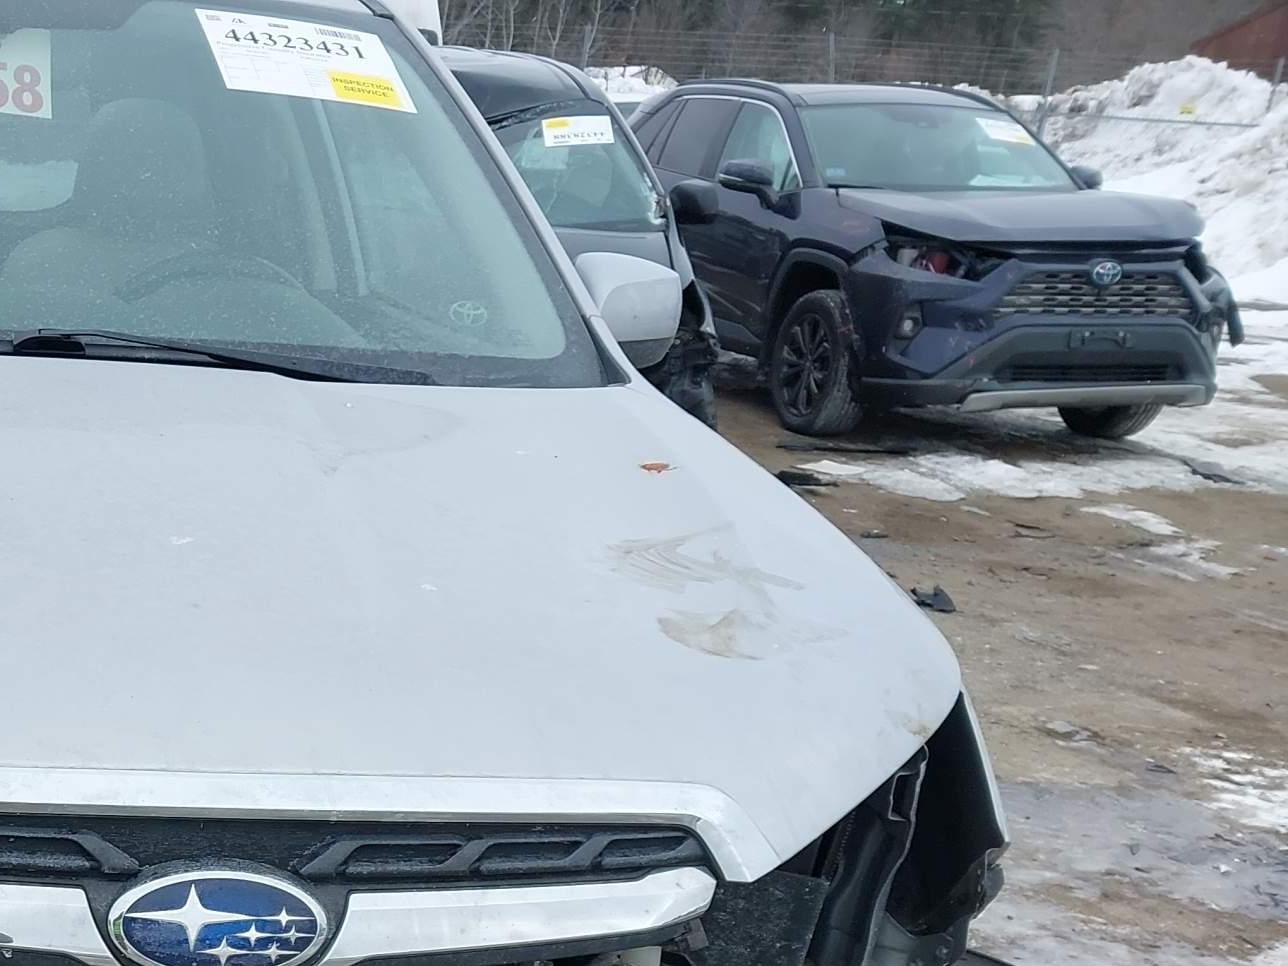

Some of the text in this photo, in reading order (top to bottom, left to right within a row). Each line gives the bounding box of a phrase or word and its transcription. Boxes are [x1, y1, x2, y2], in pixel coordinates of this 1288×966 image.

[224, 28, 366, 60] 44323431
[332, 76, 394, 92] INSPECTION
[343, 85, 392, 98] SERVICE
